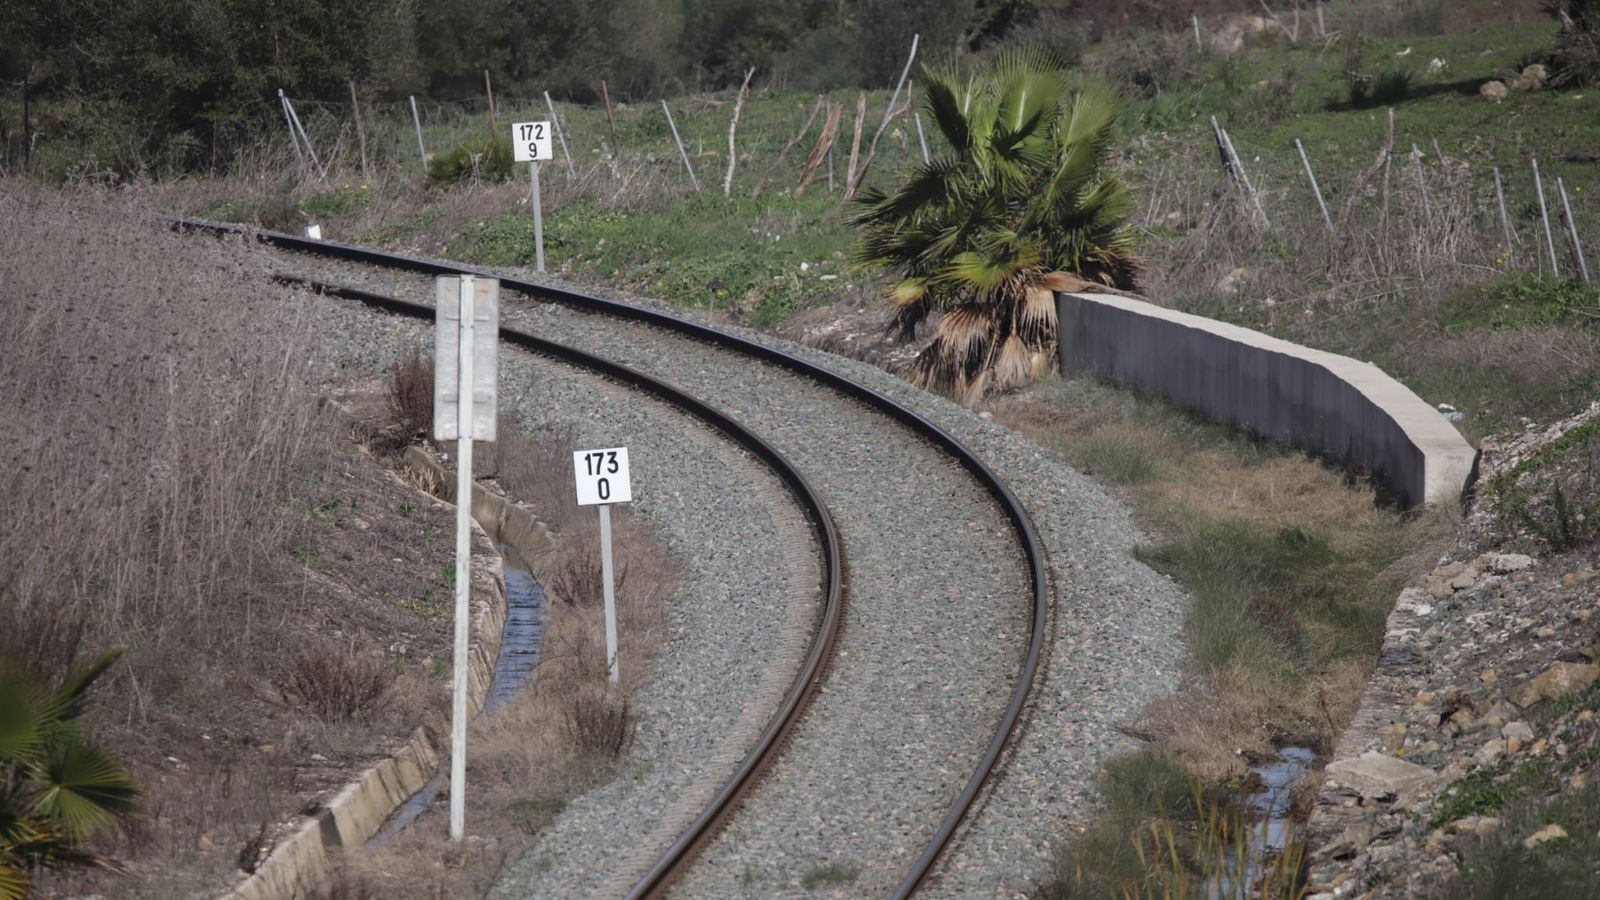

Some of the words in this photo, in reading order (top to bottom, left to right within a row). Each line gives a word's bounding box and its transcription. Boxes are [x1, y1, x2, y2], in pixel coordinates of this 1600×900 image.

[520, 124, 544, 141] 172
[528, 142, 538, 158] 9
[584, 451, 619, 476] 173
[597, 477, 611, 500] 0
